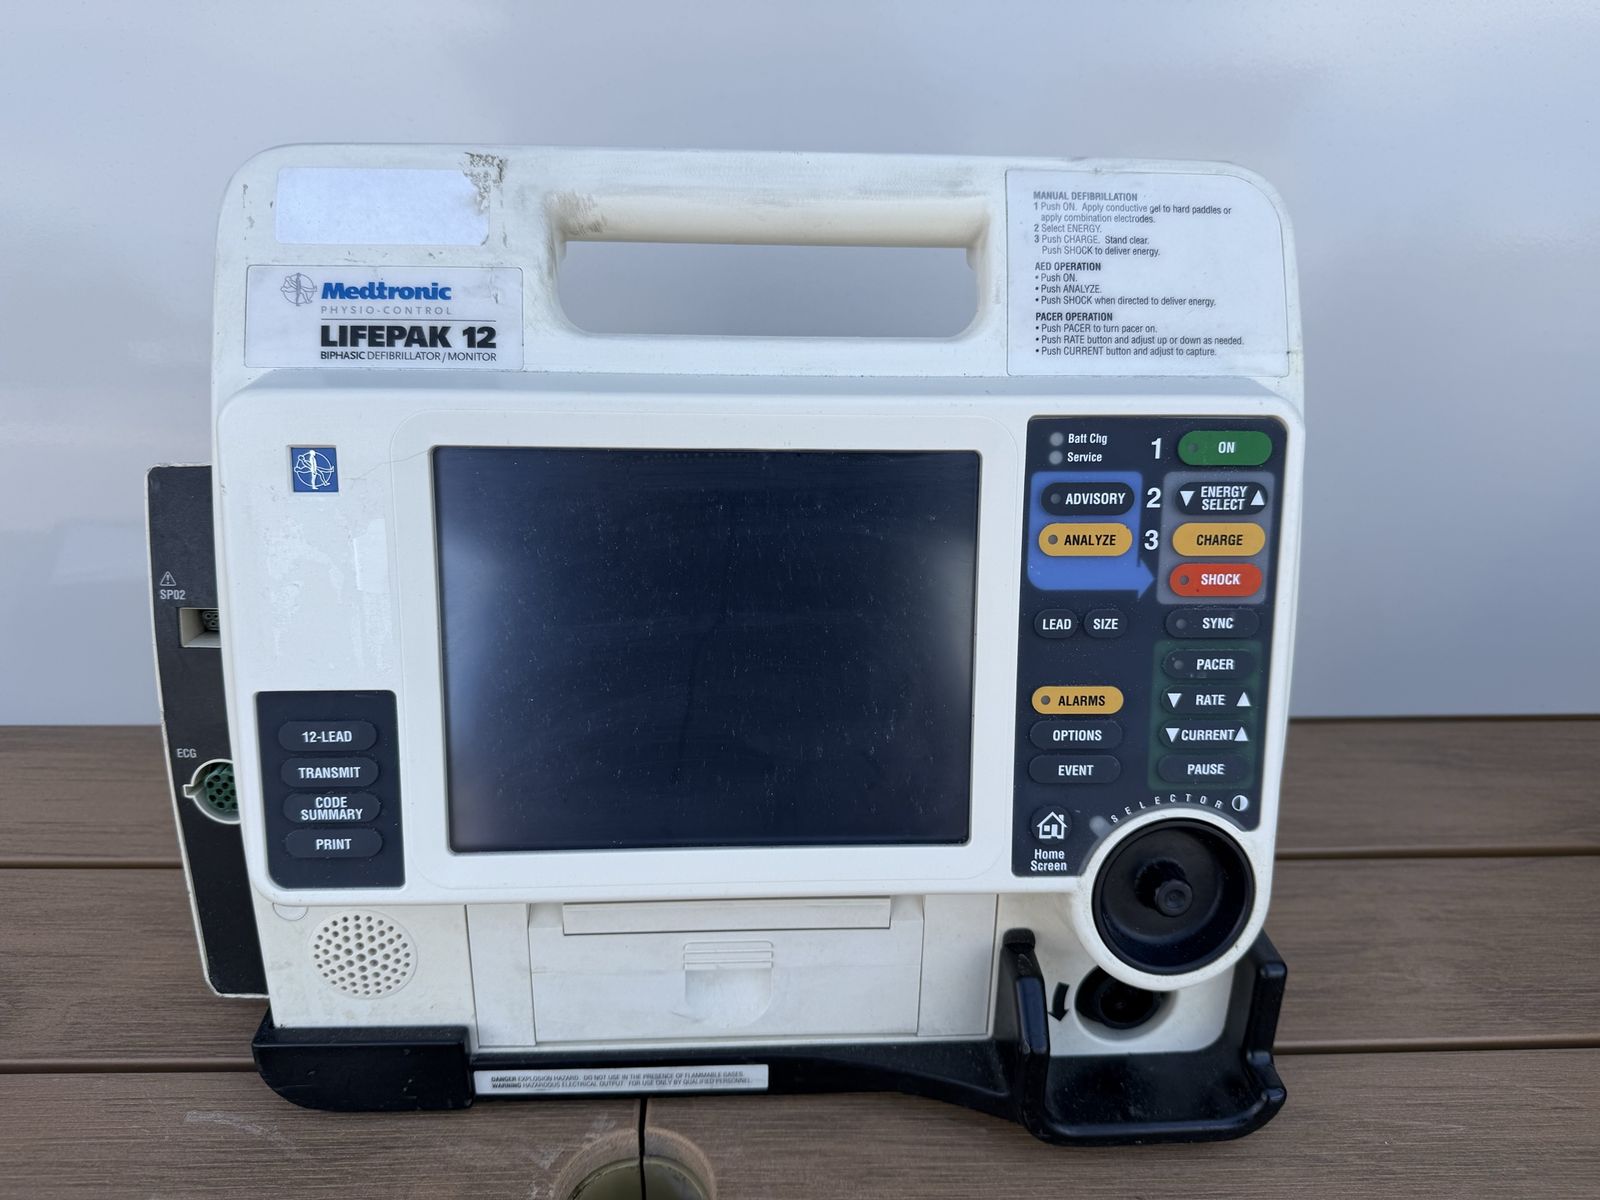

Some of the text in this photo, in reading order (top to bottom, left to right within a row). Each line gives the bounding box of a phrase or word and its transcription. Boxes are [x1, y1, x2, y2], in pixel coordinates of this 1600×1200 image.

[1033, 191, 1138, 202] MANUAL DEFIBRILLATION
[1034, 202, 1038, 210] 1
[1040, 202, 1060, 211] Push
[1062, 202, 1077, 211] ON.
[1082, 202, 1104, 213] Apply
[1106, 204, 1148, 212] conductive
[1150, 204, 1160, 214] gel
[1162, 205, 1170, 213] to
[1172, 204, 1190, 214] hard
[1192, 205, 1221, 215] paddles
[1040, 214, 1156, 223] apply combination electrodes.
[1034, 224, 1102, 232] 2 Select ENERGY.
[1034, 234, 1150, 245] 3 Push CHARGE. Stand clear.
[1042, 246, 1160, 258] Push SHOCK to deliver energy.
[1034, 262, 1102, 271] AED OPERATION
[1040, 273, 1078, 282] Push ON.
[322, 282, 452, 300] Medtronic
[1041, 284, 1102, 294] Push ANALYZE.
[1041, 296, 1216, 308] Push SHOCK when directed to deliver energy.
[321, 306, 452, 315] PHYSIO-CONTROL
[1036, 312, 1113, 321] PACER OPERATION
[1042, 324, 1061, 332] Push
[1064, 324, 1090, 332] PACER
[1093, 324, 1100, 332] to
[1103, 324, 1120, 332] turn
[1121, 325, 1143, 334] pacer
[321, 325, 496, 348] LIFEPAK 12
[1042, 335, 1062, 344] Push
[1064, 335, 1084, 344] RATE
[1086, 336, 1112, 344] button
[1114, 336, 1128, 344] and
[1130, 336, 1155, 346] adjust
[1157, 337, 1167, 346] up
[1180, 336, 1200, 345] down
[1214, 336, 1244, 345] needed.
[320, 351, 366, 360] BIPHASIC
[1042, 346, 1216, 357] Push CURRENT button and adjust to capture.
[1068, 434, 1108, 445] Batt Chg
[1151, 438, 1161, 459] 1
[1218, 442, 1235, 453] ON
[1067, 452, 1102, 462] Service
[1065, 492, 1126, 504] ADVISORY
[1146, 487, 1162, 508] 2
[1200, 486, 1248, 498] ENERGY
[1202, 498, 1245, 510] SELECT
[1064, 534, 1116, 546] ANALYZE
[1144, 530, 1159, 550] 3
[1196, 534, 1244, 546] CHARGE
[1200, 574, 1240, 586] SHOCK
[1042, 618, 1072, 630] LEAD
[1093, 618, 1118, 630] SIZE
[1202, 618, 1234, 630] SYNC
[1196, 659, 1234, 670] PACER
[1058, 695, 1106, 706] ALARMS
[1195, 694, 1226, 706] RATE
[302, 731, 352, 743] 12-LEAD
[1052, 730, 1102, 741] OPTIONS
[1181, 729, 1234, 741] CURRENT
[177, 748, 197, 758] ECG
[298, 766, 361, 779] TRANSMIT
[1058, 764, 1094, 776] EVENT
[1187, 764, 1225, 776] PAUSE
[315, 796, 348, 808] CODE
[301, 808, 363, 820] SUMMARY
[1111, 794, 1223, 823] SELECTOR
[316, 838, 352, 850] PRINT
[1034, 848, 1065, 860] Home
[1030, 860, 1068, 872] Screen
